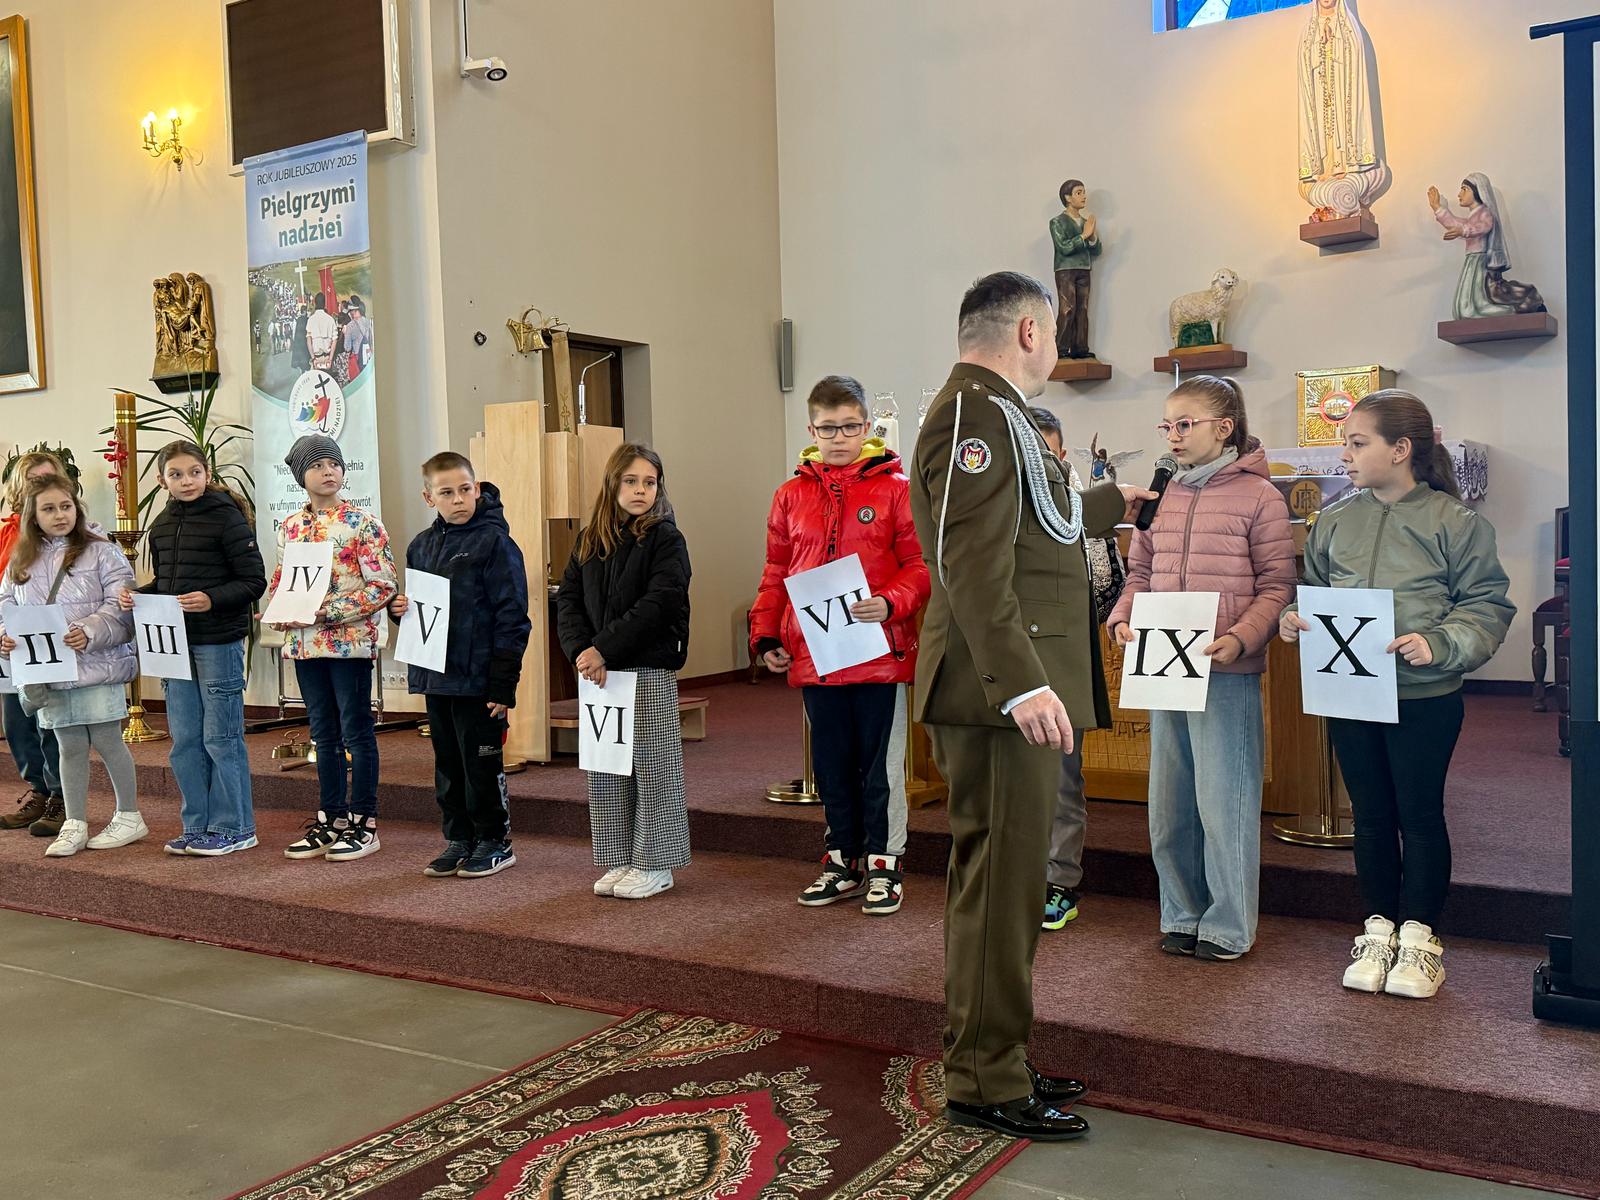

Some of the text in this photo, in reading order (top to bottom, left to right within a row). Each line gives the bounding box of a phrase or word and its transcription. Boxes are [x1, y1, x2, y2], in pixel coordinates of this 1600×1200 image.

[257, 153, 357, 186] ROK JUBILEUSZOWY 2025
[261, 178, 355, 220] Pielgrzymi
[278, 214, 343, 248] nadziei
[269, 502, 276, 511] w
[276, 498, 297, 513] ufnym
[287, 565, 324, 593] IV
[142, 622, 181, 655] III
[413, 599, 442, 646] V
[18, 631, 63, 666] II
[1128, 627, 1209, 679] IX
[1312, 613, 1379, 678] X
[585, 702, 628, 745] VI
